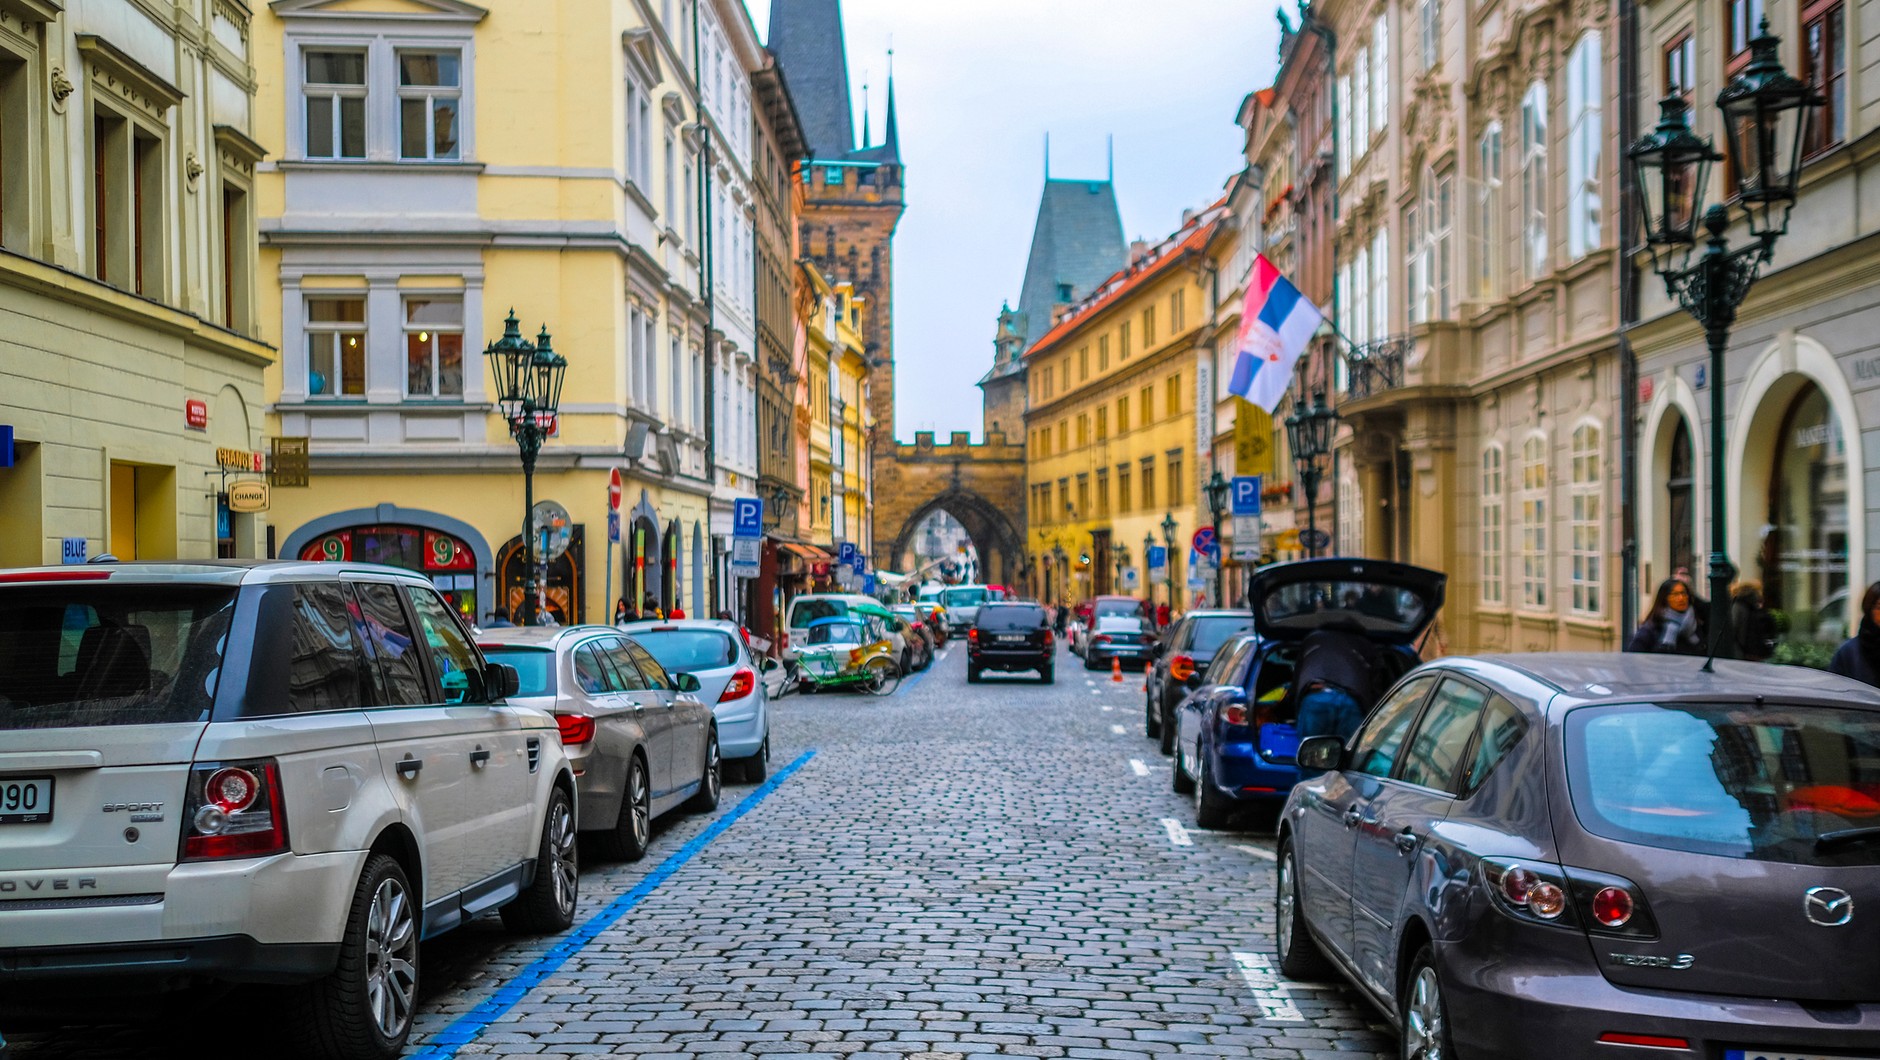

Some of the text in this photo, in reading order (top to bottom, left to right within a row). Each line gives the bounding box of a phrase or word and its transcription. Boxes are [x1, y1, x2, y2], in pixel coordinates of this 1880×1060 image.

[235, 491, 263, 500] CHANGE
[1238, 482, 1253, 502] P
[741, 504, 757, 525] P
[64, 540, 86, 558] BLUE
[323, 537, 345, 561] 9
[433, 536, 454, 566] 9
[842, 545, 853, 558] P
[0, 783, 38, 811] 90
[103, 801, 164, 812] SPORT
